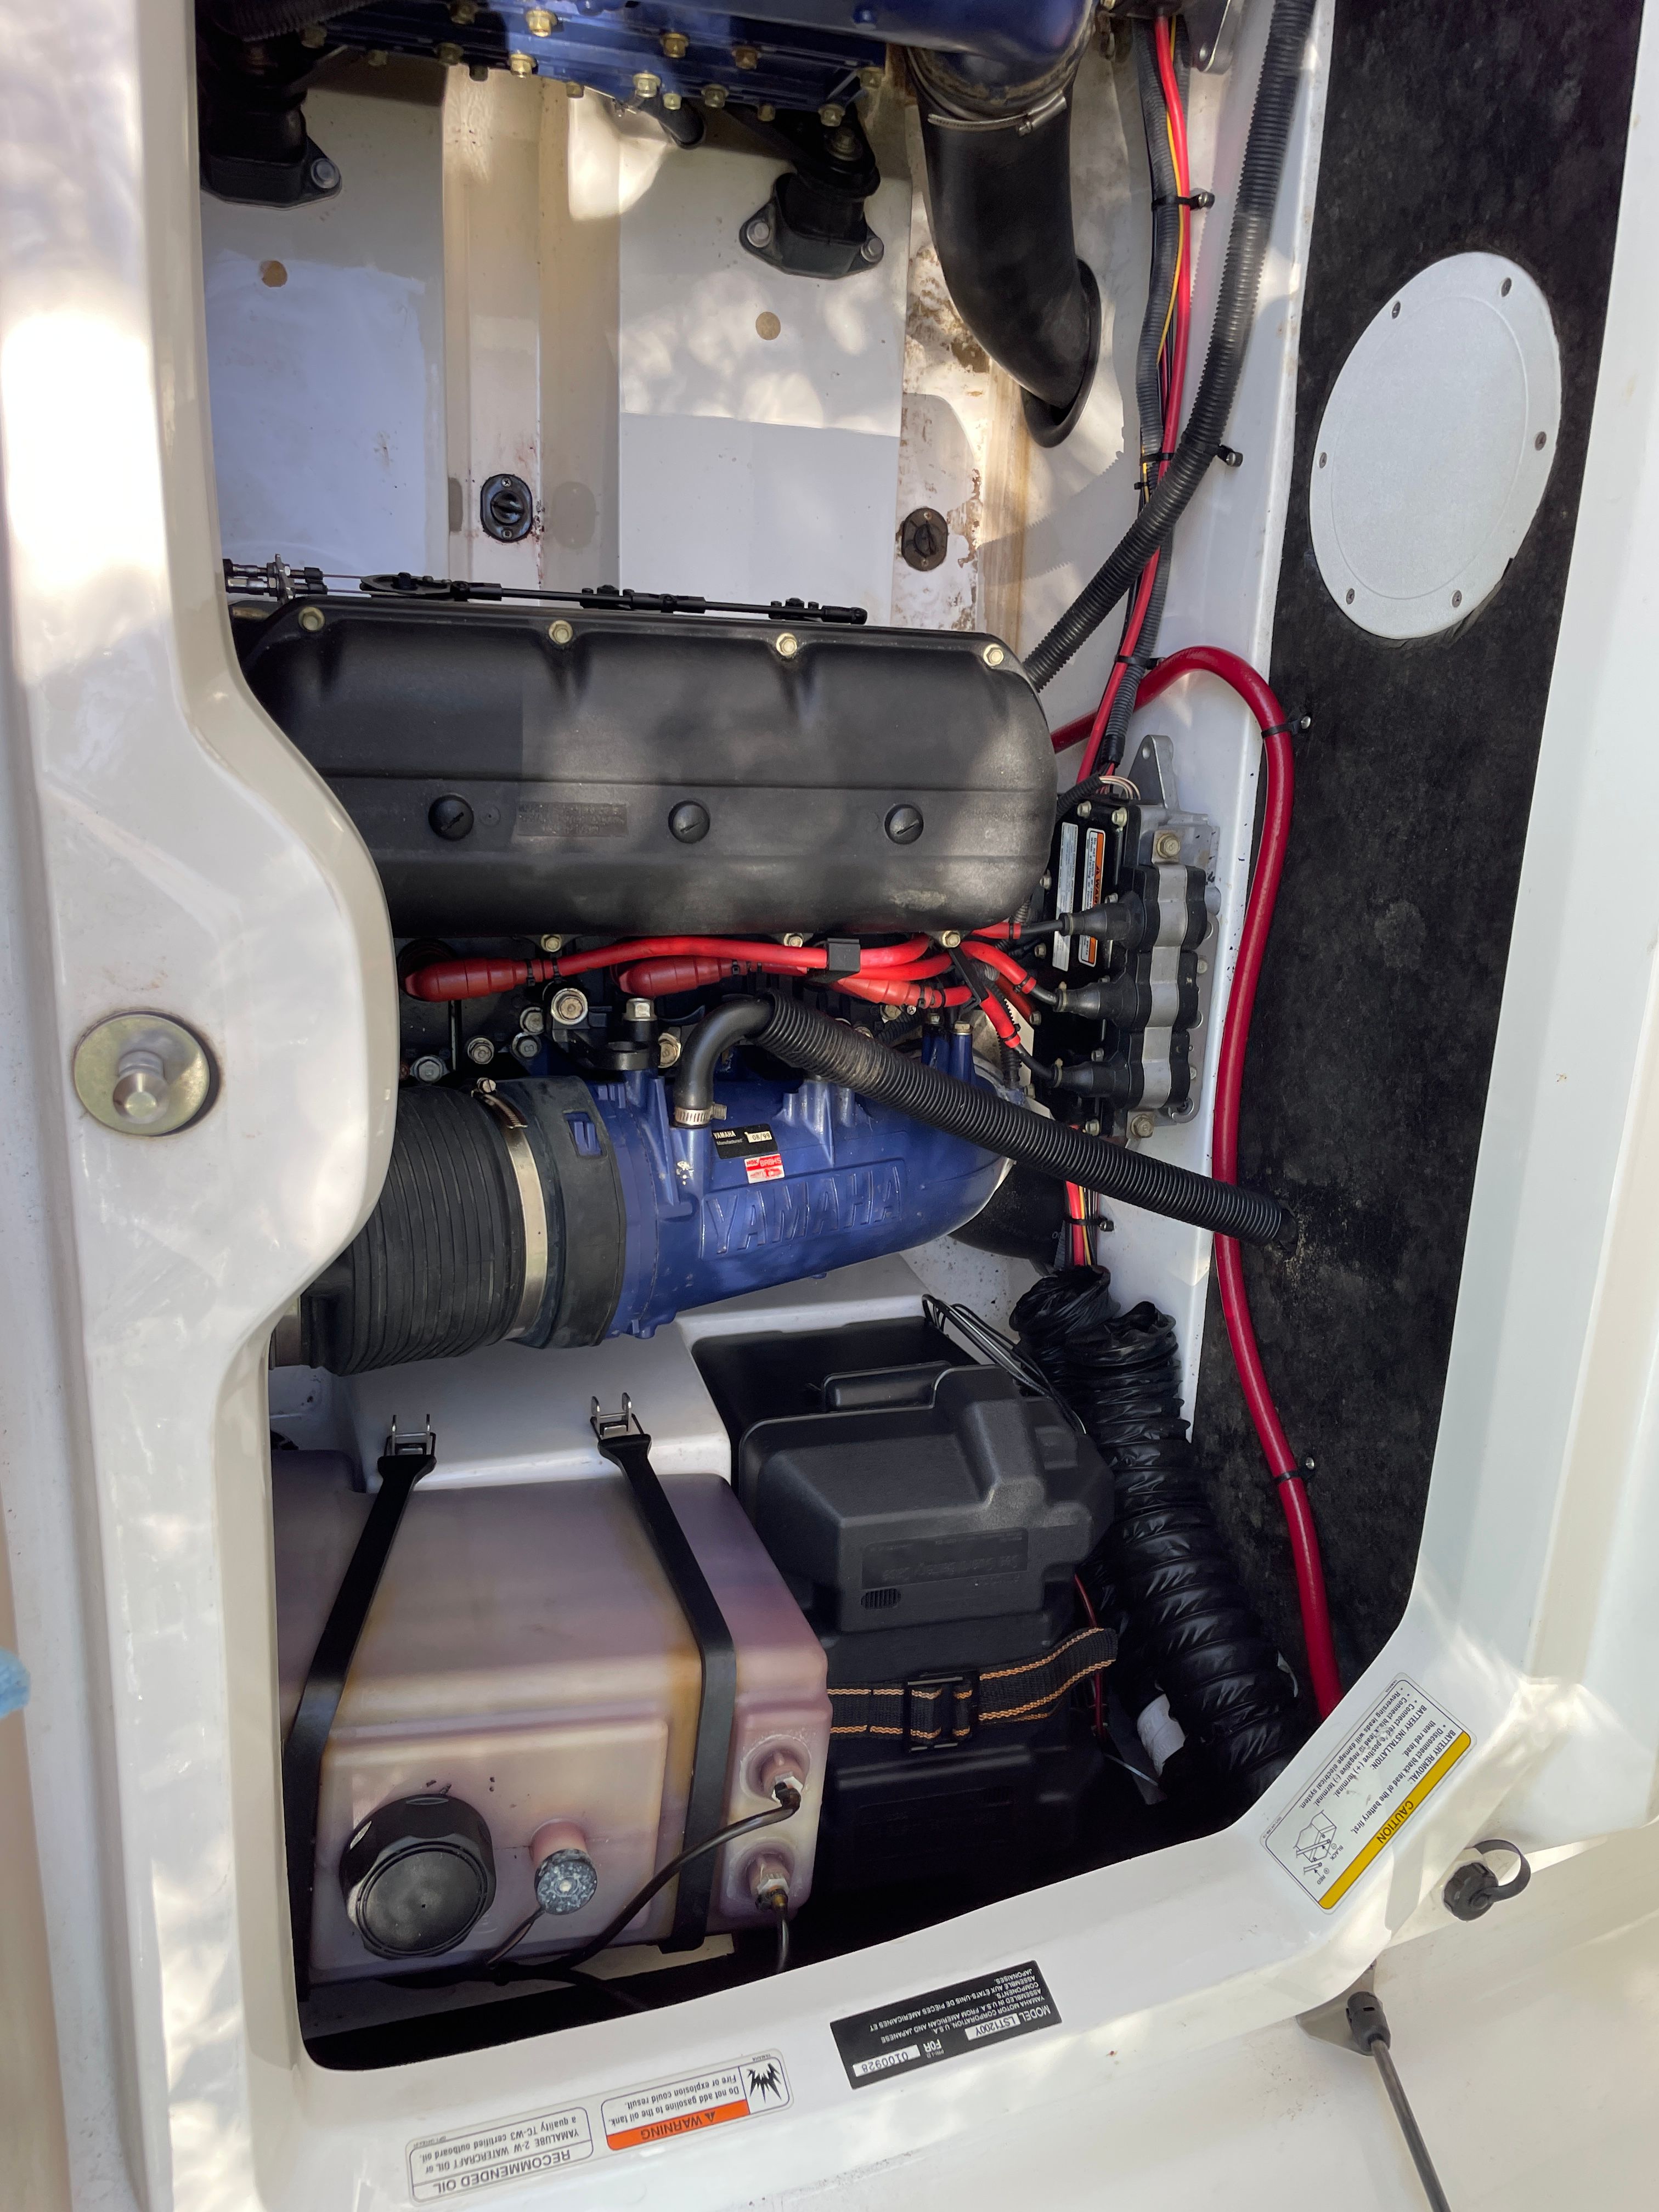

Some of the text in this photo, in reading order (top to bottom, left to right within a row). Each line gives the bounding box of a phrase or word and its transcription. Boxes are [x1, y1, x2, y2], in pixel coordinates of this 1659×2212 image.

[712, 1130, 736, 1139] YAMAHA
[752, 1132, 770, 1142] 08/99
[705, 1164, 902, 1255] YAMAHA
[1374, 1690, 1401, 1719] Reversing
[1385, 1696, 1408, 1720] Connect
[1392, 1702, 1415, 1727] Connect
[1402, 1703, 1427, 1731] BATTERY
[1362, 1716, 1379, 1734] leads
[1421, 1719, 1436, 1735] then
[1354, 1731, 1366, 1744] will
[1413, 1731, 1426, 1745] red
[1414, 1727, 1444, 1759] Disconnect
[1431, 1729, 1457, 1756] BATTERY
[1335, 1741, 1357, 1765] damage
[1360, 1739, 1384, 1764] positive
[1338, 1750, 1362, 1776] negative
[1351, 1760, 1365, 1775] (+)
[1402, 1756, 1419, 1774] black
[1314, 1763, 1339, 1790] electrical
[1391, 1771, 1407, 1787] lead
[1378, 1790, 1390, 1803] the
[1386, 1784, 1396, 1793] of
[1360, 1799, 1383, 1822] battery
[1374, 1798, 1415, 1844] CAUTION
[1329, 1844, 1344, 1861] BLACK
[1315, 1874, 1326, 1885] RED
[990, 1984, 1003, 1994] AUX
[1005, 1988, 1042, 2004] ASSEMBLED
[945, 1999, 955, 2008] DE
[996, 2002, 1020, 2015] MOTOR
[1019, 1994, 1045, 2008] YAMAHA
[927, 2012, 961, 2029] AMERICAN
[960, 2006, 980, 2018] FROM
[973, 2003, 1051, 2036] MODEL LST1200Y
[868, 2023, 878, 2032] ET
[879, 2027, 913, 2044] JAPANESE
[912, 2023, 928, 2033] AND
[860, 2038, 942, 2074] FOR 0100928
[624, 2074, 737, 2111] Fire or explosion could result.
[607, 2085, 740, 2128] Do not add gasoline to the oil tank.
[539, 2115, 569, 2132] quality
[639, 2114, 703, 2140] WARNING
[509, 2125, 538, 2140] TC-W3
[472, 2133, 507, 2150] certified
[423, 2127, 579, 2175] YAMALUBE 2-W WATERCRAFT OIL or
[433, 2142, 472, 2160] outboard
[431, 2148, 572, 2196] RECOMMENDED OIL
